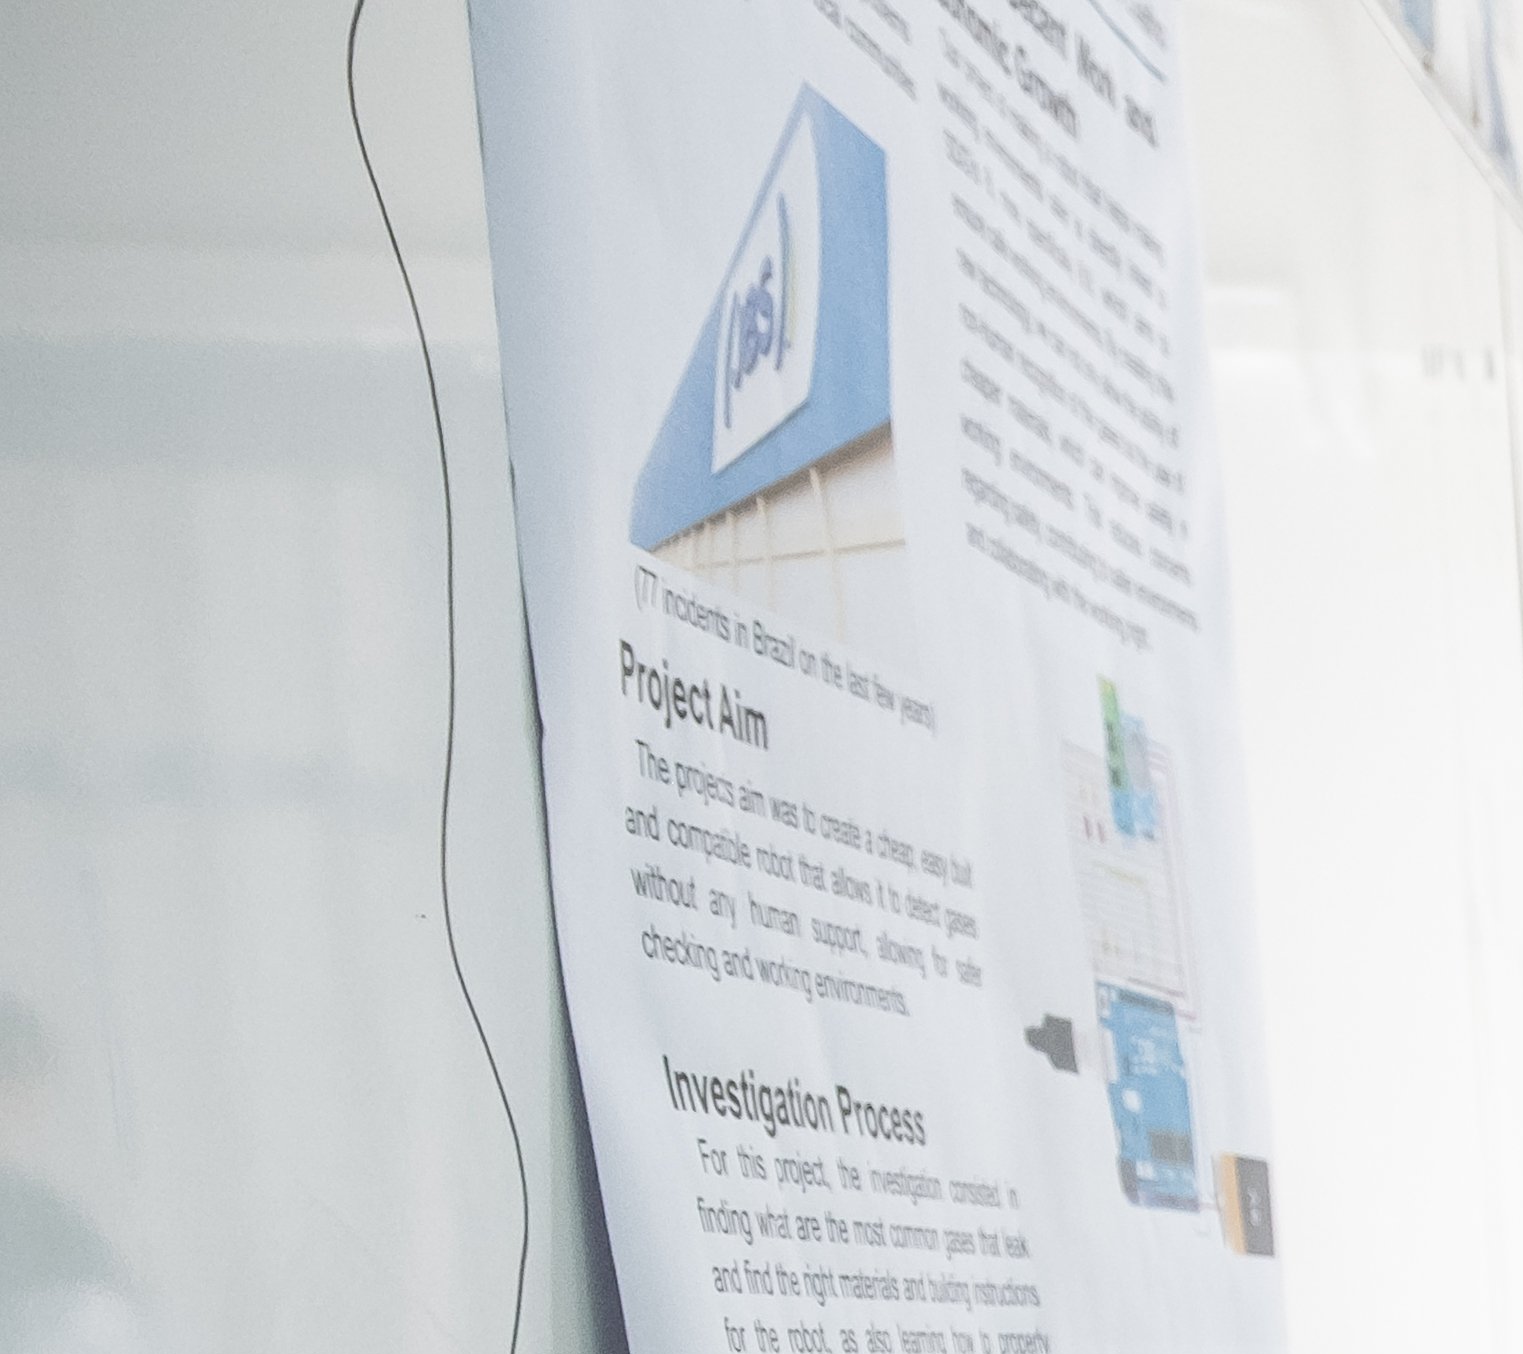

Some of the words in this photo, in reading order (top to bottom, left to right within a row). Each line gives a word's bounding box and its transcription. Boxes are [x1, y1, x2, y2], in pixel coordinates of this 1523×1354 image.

[661, 577, 731, 643] incidents
[733, 612, 749, 648] in
[752, 619, 796, 669] Brazil
[619, 638, 714, 729] Project
[719, 683, 769, 751] Aim
[634, 739, 671, 785] The
[738, 778, 766, 817] aim
[770, 797, 799, 829] was
[801, 801, 816, 835] to
[820, 813, 862, 851] create
[625, 805, 660, 841] and
[756, 845, 797, 884] robot
[799, 856, 827, 892] that
[830, 865, 873, 905] allows
[630, 861, 698, 911] without
[708, 887, 738, 929] any
[747, 890, 799, 937] human
[641, 924, 722, 982] checking
[721, 947, 755, 981] and
[755, 954, 814, 1005] working
[661, 1053, 834, 1138] Investigation
[835, 1084, 929, 1147] Process
[696, 1137, 729, 1176] For
[736, 1144, 767, 1181] this
[774, 1151, 832, 1194] project,
[836, 1155, 861, 1193] the
[866, 1161, 942, 1206] investigation
[696, 1196, 754, 1246] finding
[755, 1202, 792, 1241] what
[794, 1214, 822, 1243] are
[824, 1209, 849, 1245] the
[852, 1216, 887, 1249] most
[888, 1222, 939, 1251] common
[711, 1259, 742, 1295] and
[744, 1259, 774, 1296] find
[775, 1262, 801, 1297] the
[802, 1264, 839, 1307] right
[838, 1267, 900, 1301] materials
[902, 1272, 928, 1303] and
[724, 1315, 747, 1352] for
[754, 1319, 780, 1352] the
[839, 1326, 858, 1354] as
[864, 1320, 893, 1354] also
